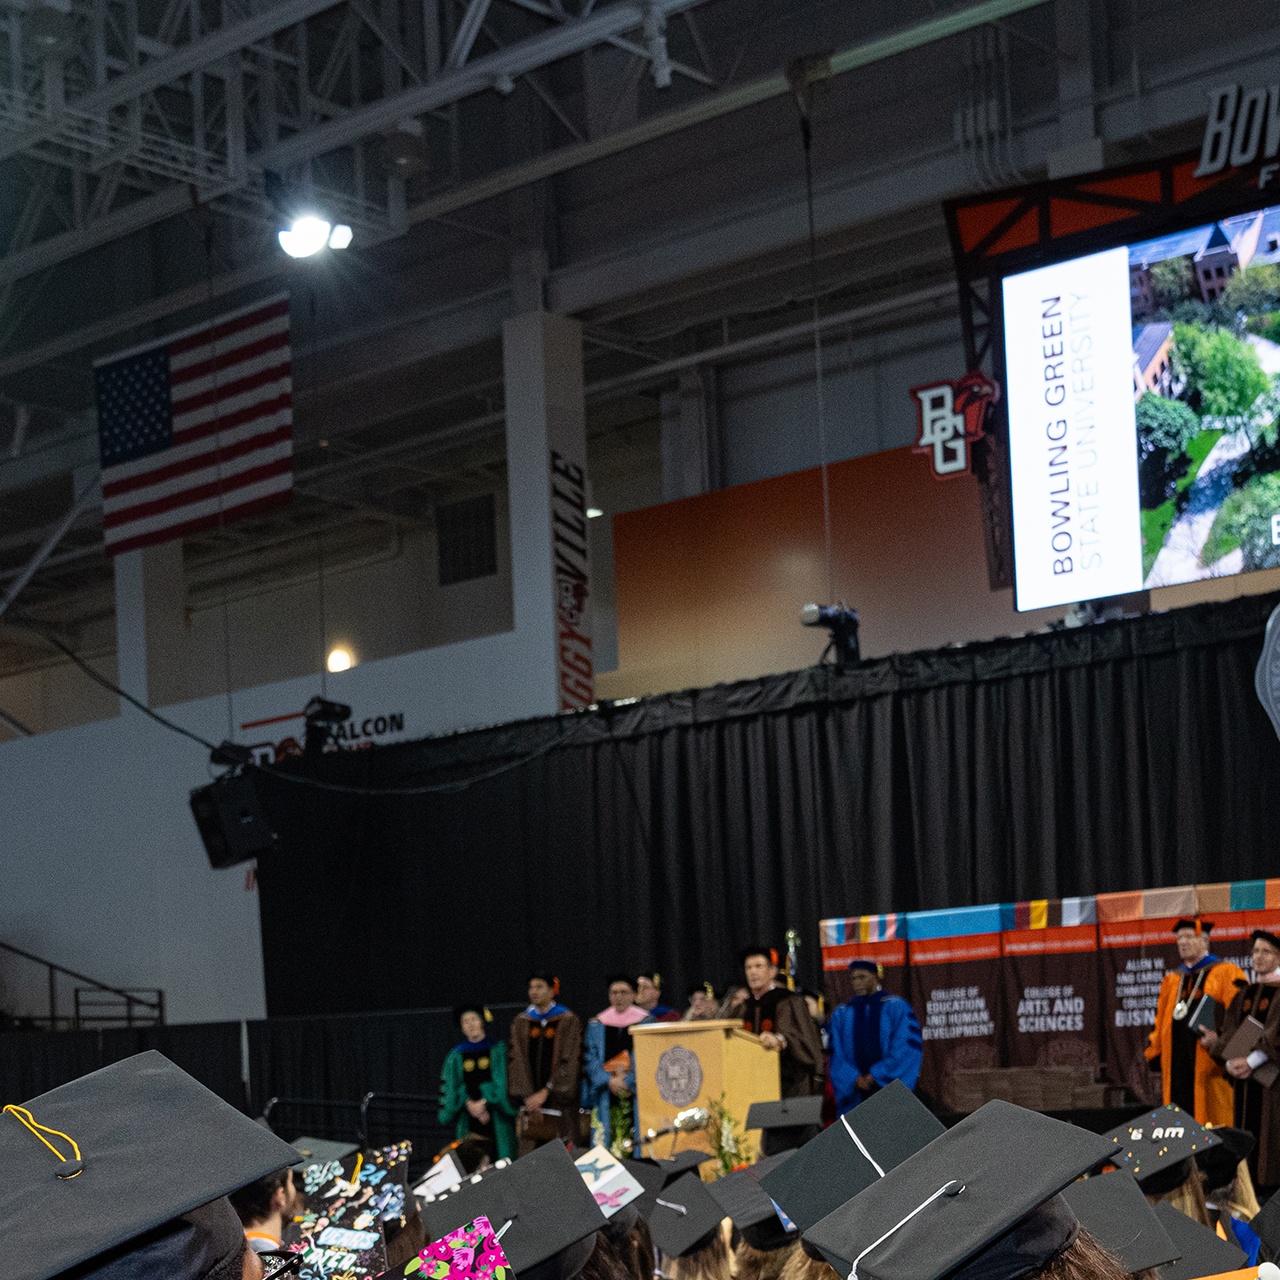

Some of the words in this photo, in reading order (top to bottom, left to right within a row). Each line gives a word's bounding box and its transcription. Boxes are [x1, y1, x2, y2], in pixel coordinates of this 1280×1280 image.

[1041, 296, 1066, 407] GREEN
[1046, 419, 1074, 576] BOWLING
[931, 987, 967, 1000] COLLEGE
[1024, 986, 1061, 999] COLLEGE
[926, 997, 987, 1014] EDUCATION
[1017, 999, 1050, 1016] ARTS
[1053, 997, 1085, 1015] AND
[948, 1009, 990, 1024] HUMAN
[1018, 1014, 1085, 1033] SCIENCES
[922, 1021, 995, 1040] DEVELOPMENT
